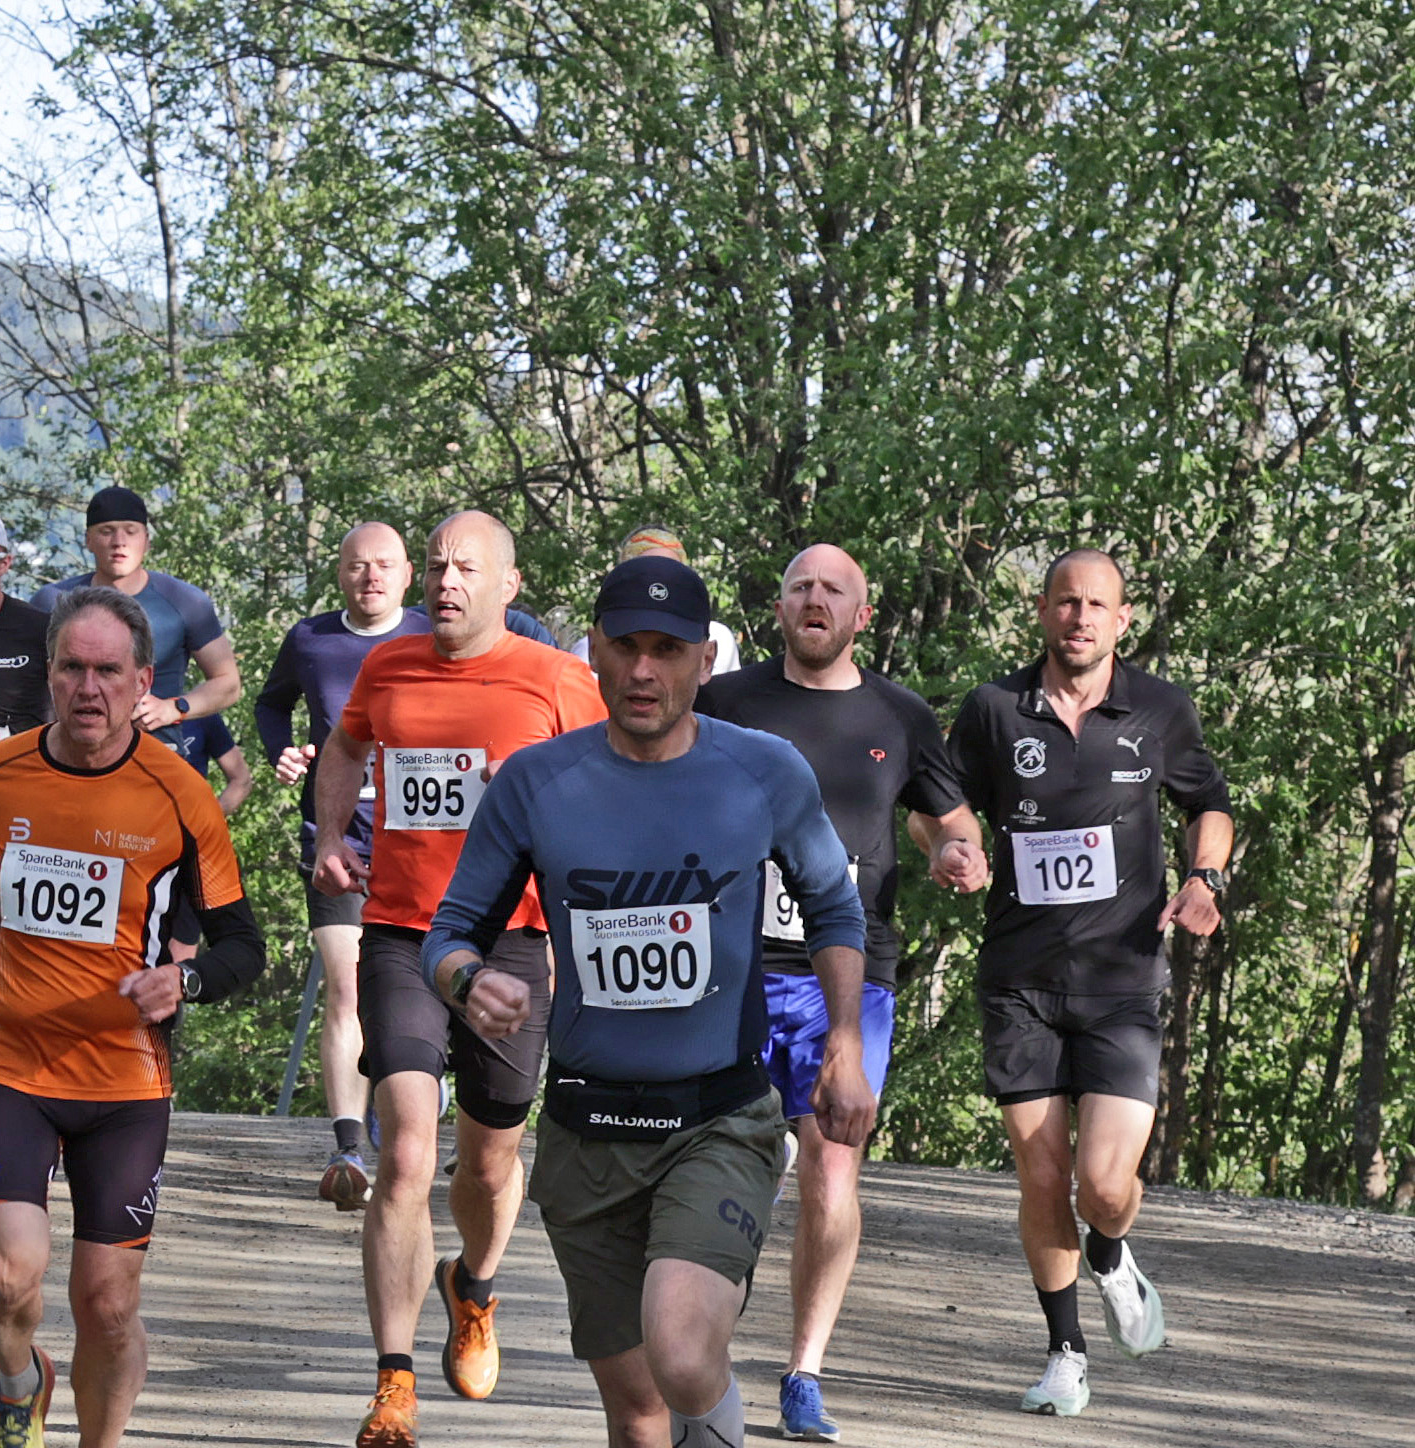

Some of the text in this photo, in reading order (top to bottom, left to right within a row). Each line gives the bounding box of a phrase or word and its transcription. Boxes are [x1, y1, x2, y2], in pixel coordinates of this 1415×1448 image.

[395, 753, 453, 765] SpareBank
[403, 776, 464, 817] 995
[1024, 834, 1081, 849] SpareBank
[19, 849, 86, 871] SpareBank
[22, 865, 85, 879] GUDBRANDSDAL
[1035, 854, 1094, 892] 102
[12, 877, 106, 928] 1092
[586, 913, 666, 932] SpareBank
[594, 929, 667, 939] GUDBRANDSDAL
[587, 941, 697, 993] 1090
[589, 1113, 682, 1129] SALOMON
